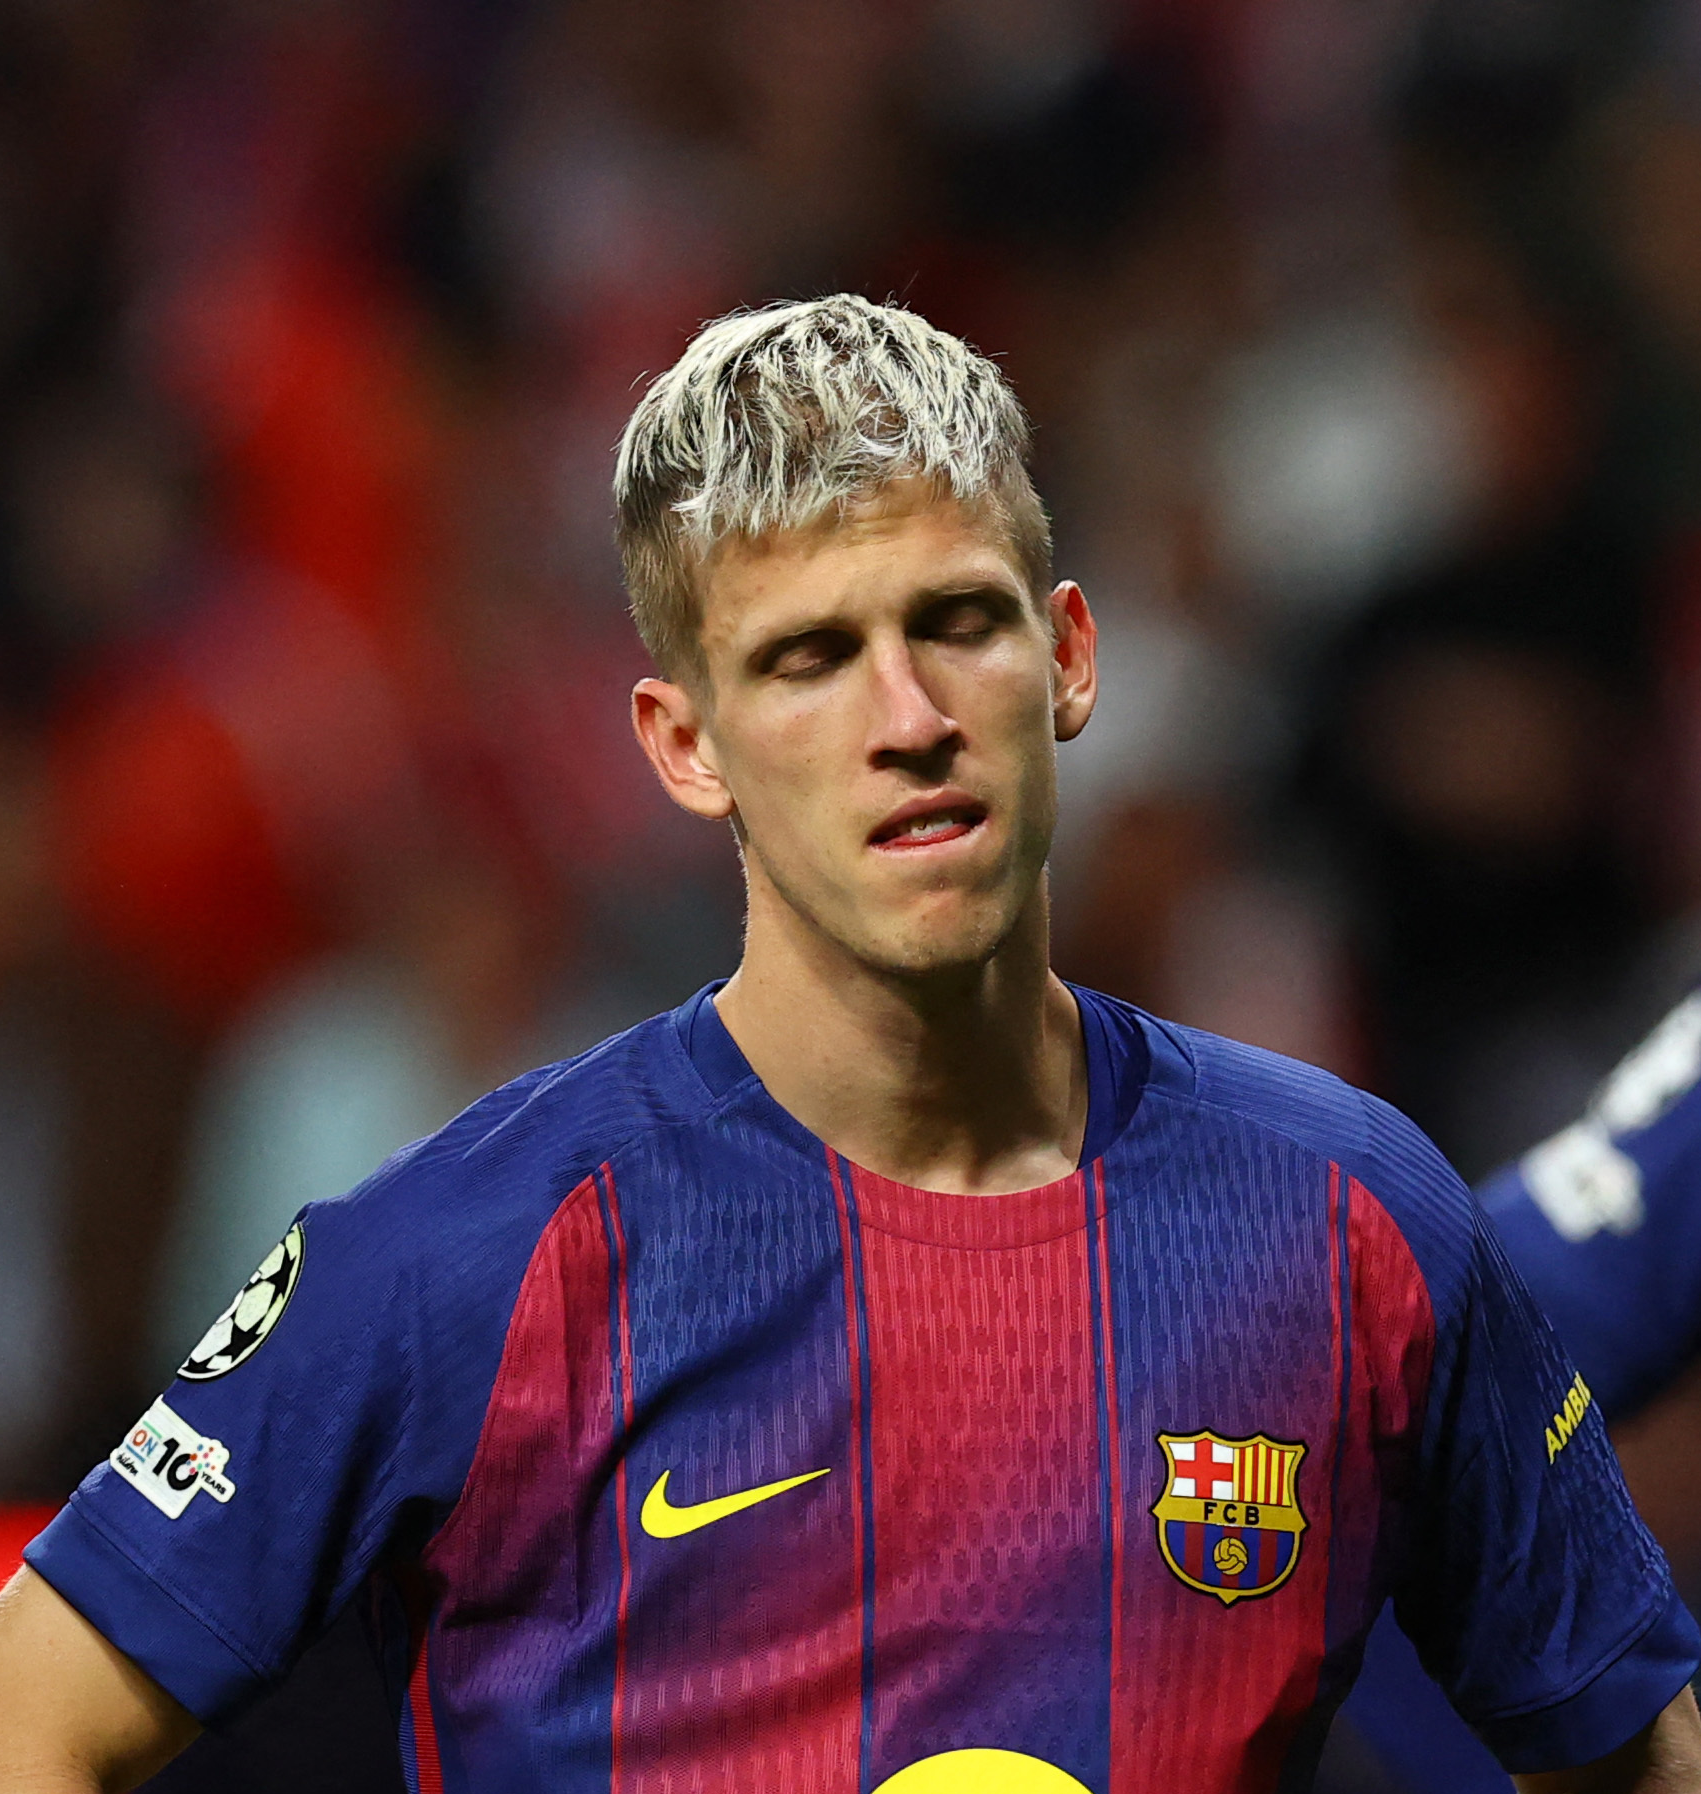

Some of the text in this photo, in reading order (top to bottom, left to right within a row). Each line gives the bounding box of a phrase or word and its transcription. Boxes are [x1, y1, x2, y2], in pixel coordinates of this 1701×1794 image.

[152, 1438, 199, 1491] 10
[201, 1471, 227, 1495] YEARS
[1204, 1502, 1260, 1525] FCB
